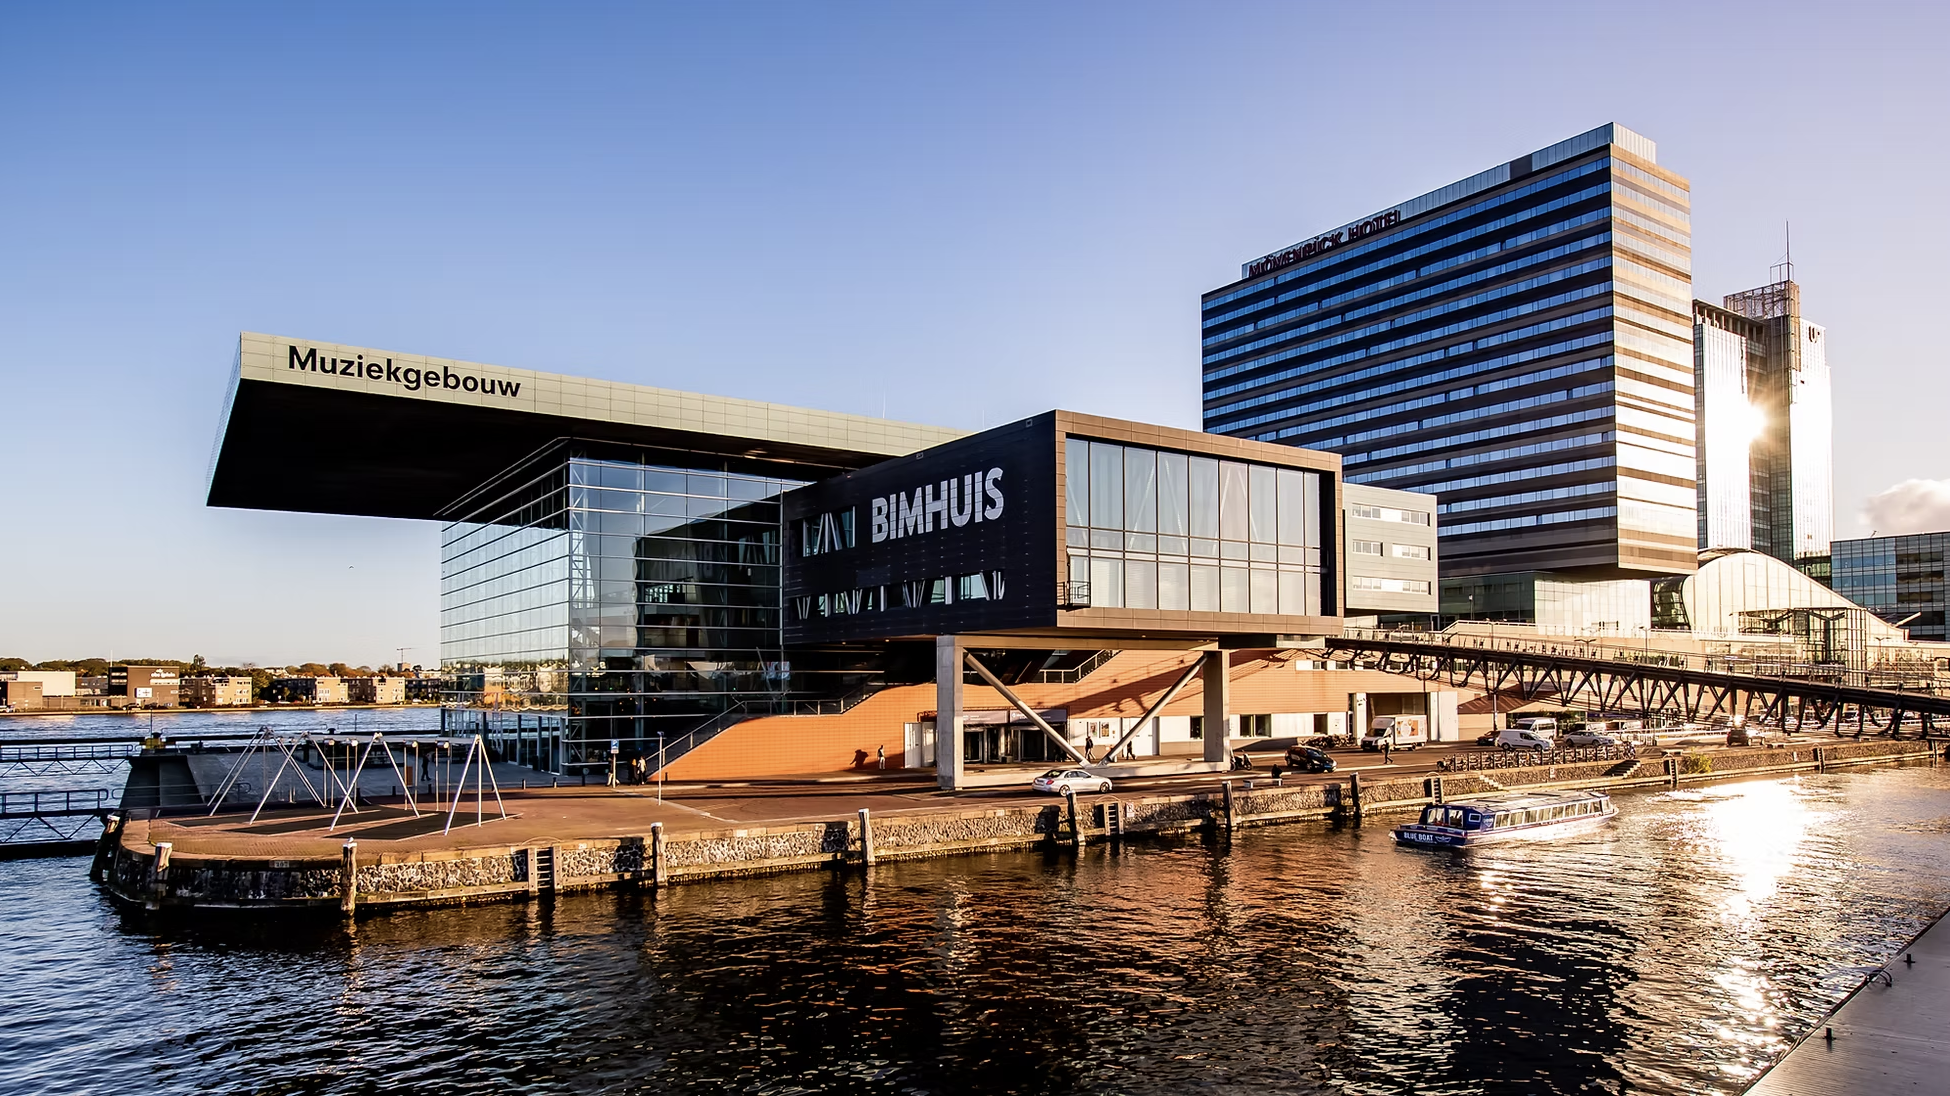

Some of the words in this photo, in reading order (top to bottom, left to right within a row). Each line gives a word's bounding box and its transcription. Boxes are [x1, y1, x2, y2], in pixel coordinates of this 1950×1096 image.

[1347, 210, 1401, 242] HOTEL
[288, 345, 521, 398] Muziekgebouw
[872, 467, 1004, 543] BIMHUIS
[1403, 831, 1418, 840] BLUE
